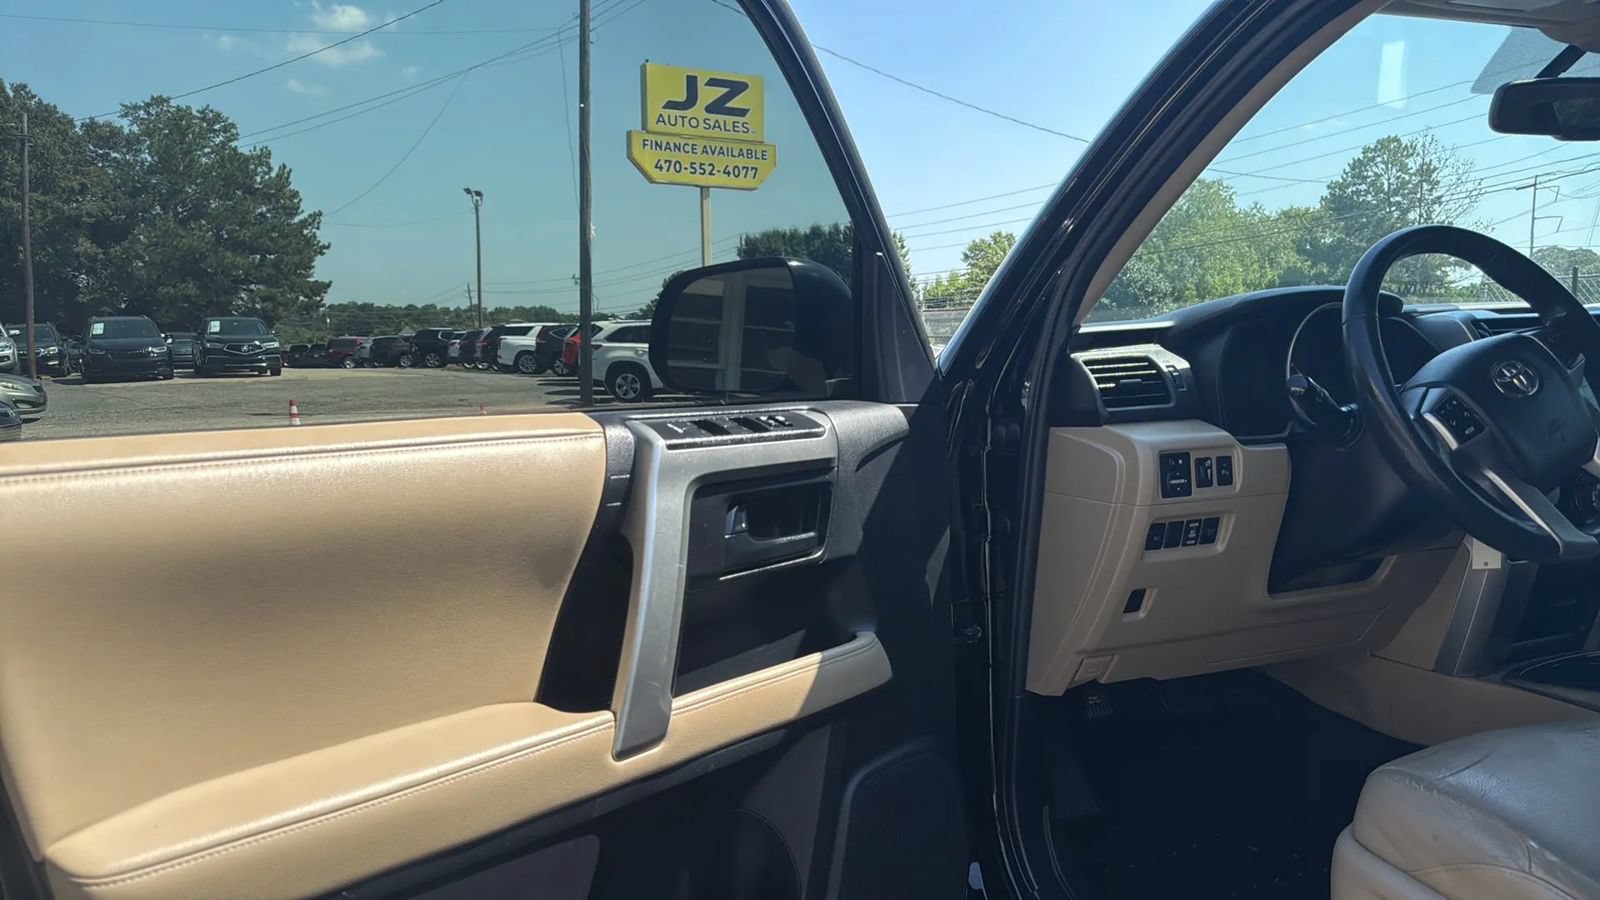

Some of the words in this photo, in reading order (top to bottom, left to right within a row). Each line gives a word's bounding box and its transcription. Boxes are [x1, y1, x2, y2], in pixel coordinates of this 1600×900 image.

[661, 74, 751, 118] JZ
[655, 113, 700, 129] AUTO
[703, 118, 750, 134] SALES
[642, 138, 698, 155] FINANCE
[700, 144, 768, 161] AVAILABLE
[654, 159, 759, 179] 470-552-4077
